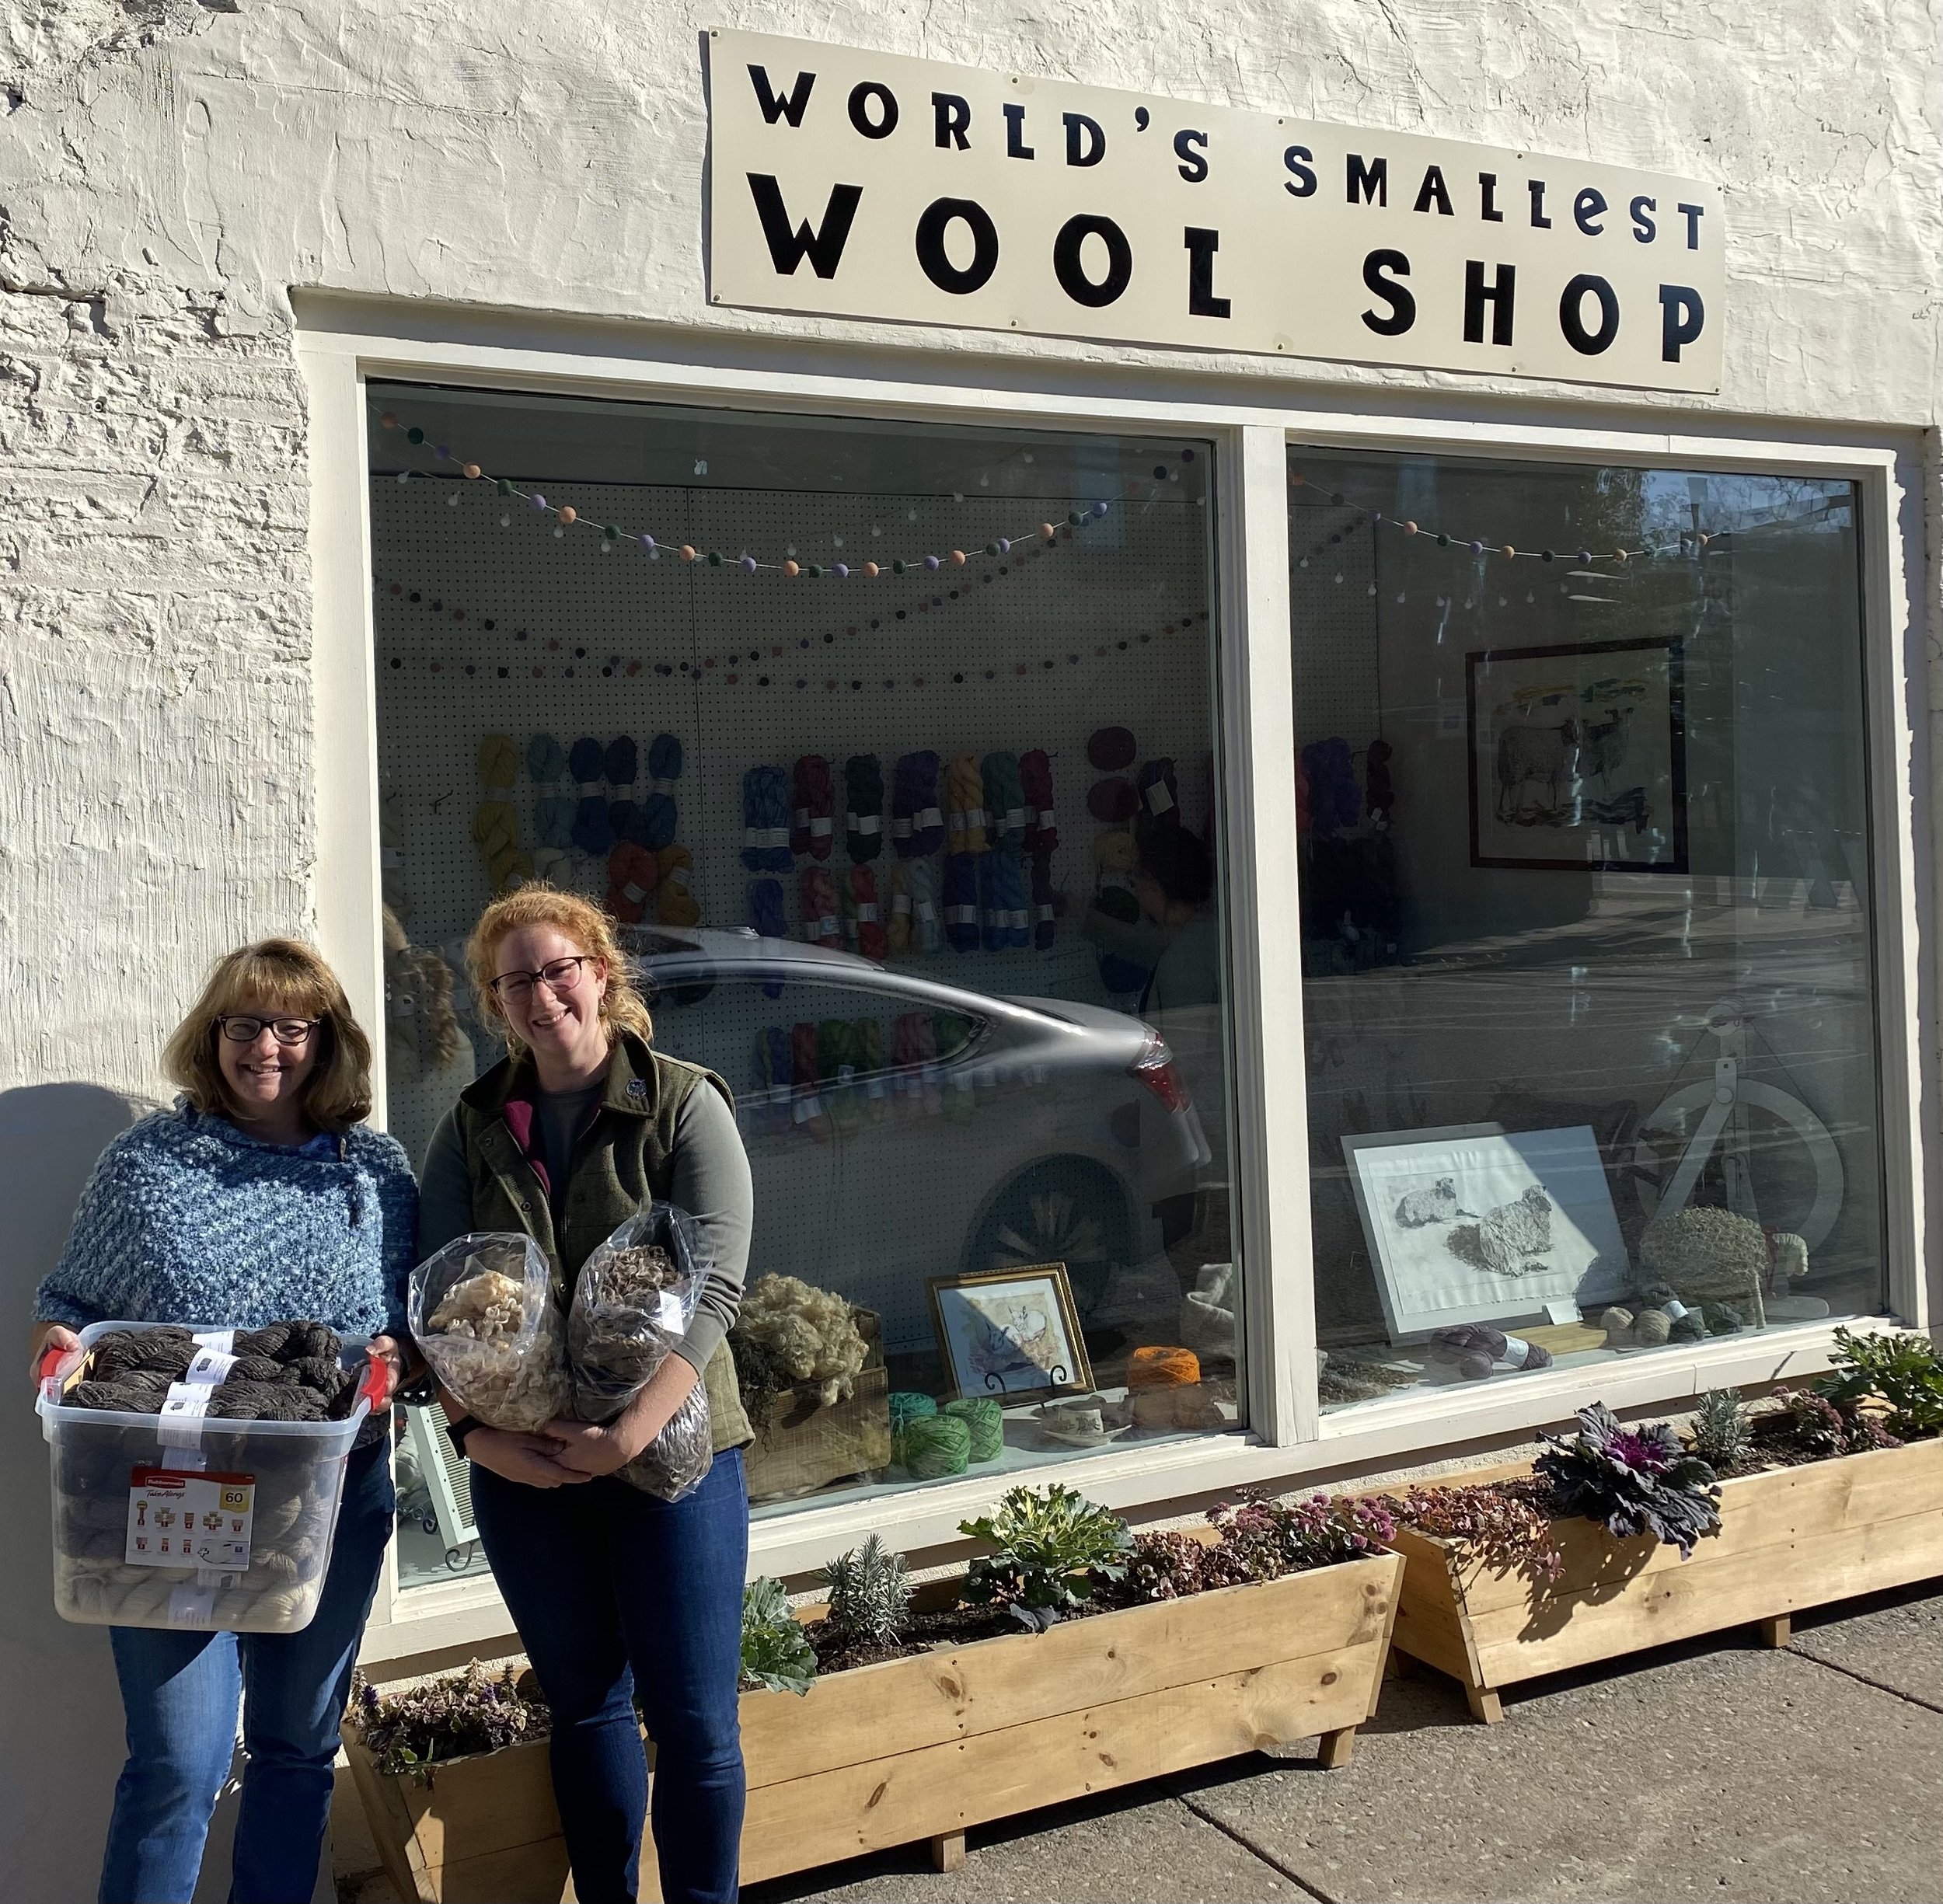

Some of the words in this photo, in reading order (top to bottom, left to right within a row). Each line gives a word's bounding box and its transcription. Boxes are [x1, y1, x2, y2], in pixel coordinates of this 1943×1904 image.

[745, 63, 1209, 184] WORLD'S
[745, 172, 1232, 319] WOOL
[1360, 249, 1705, 364] SHOP
[225, 1492, 243, 1503] 60
